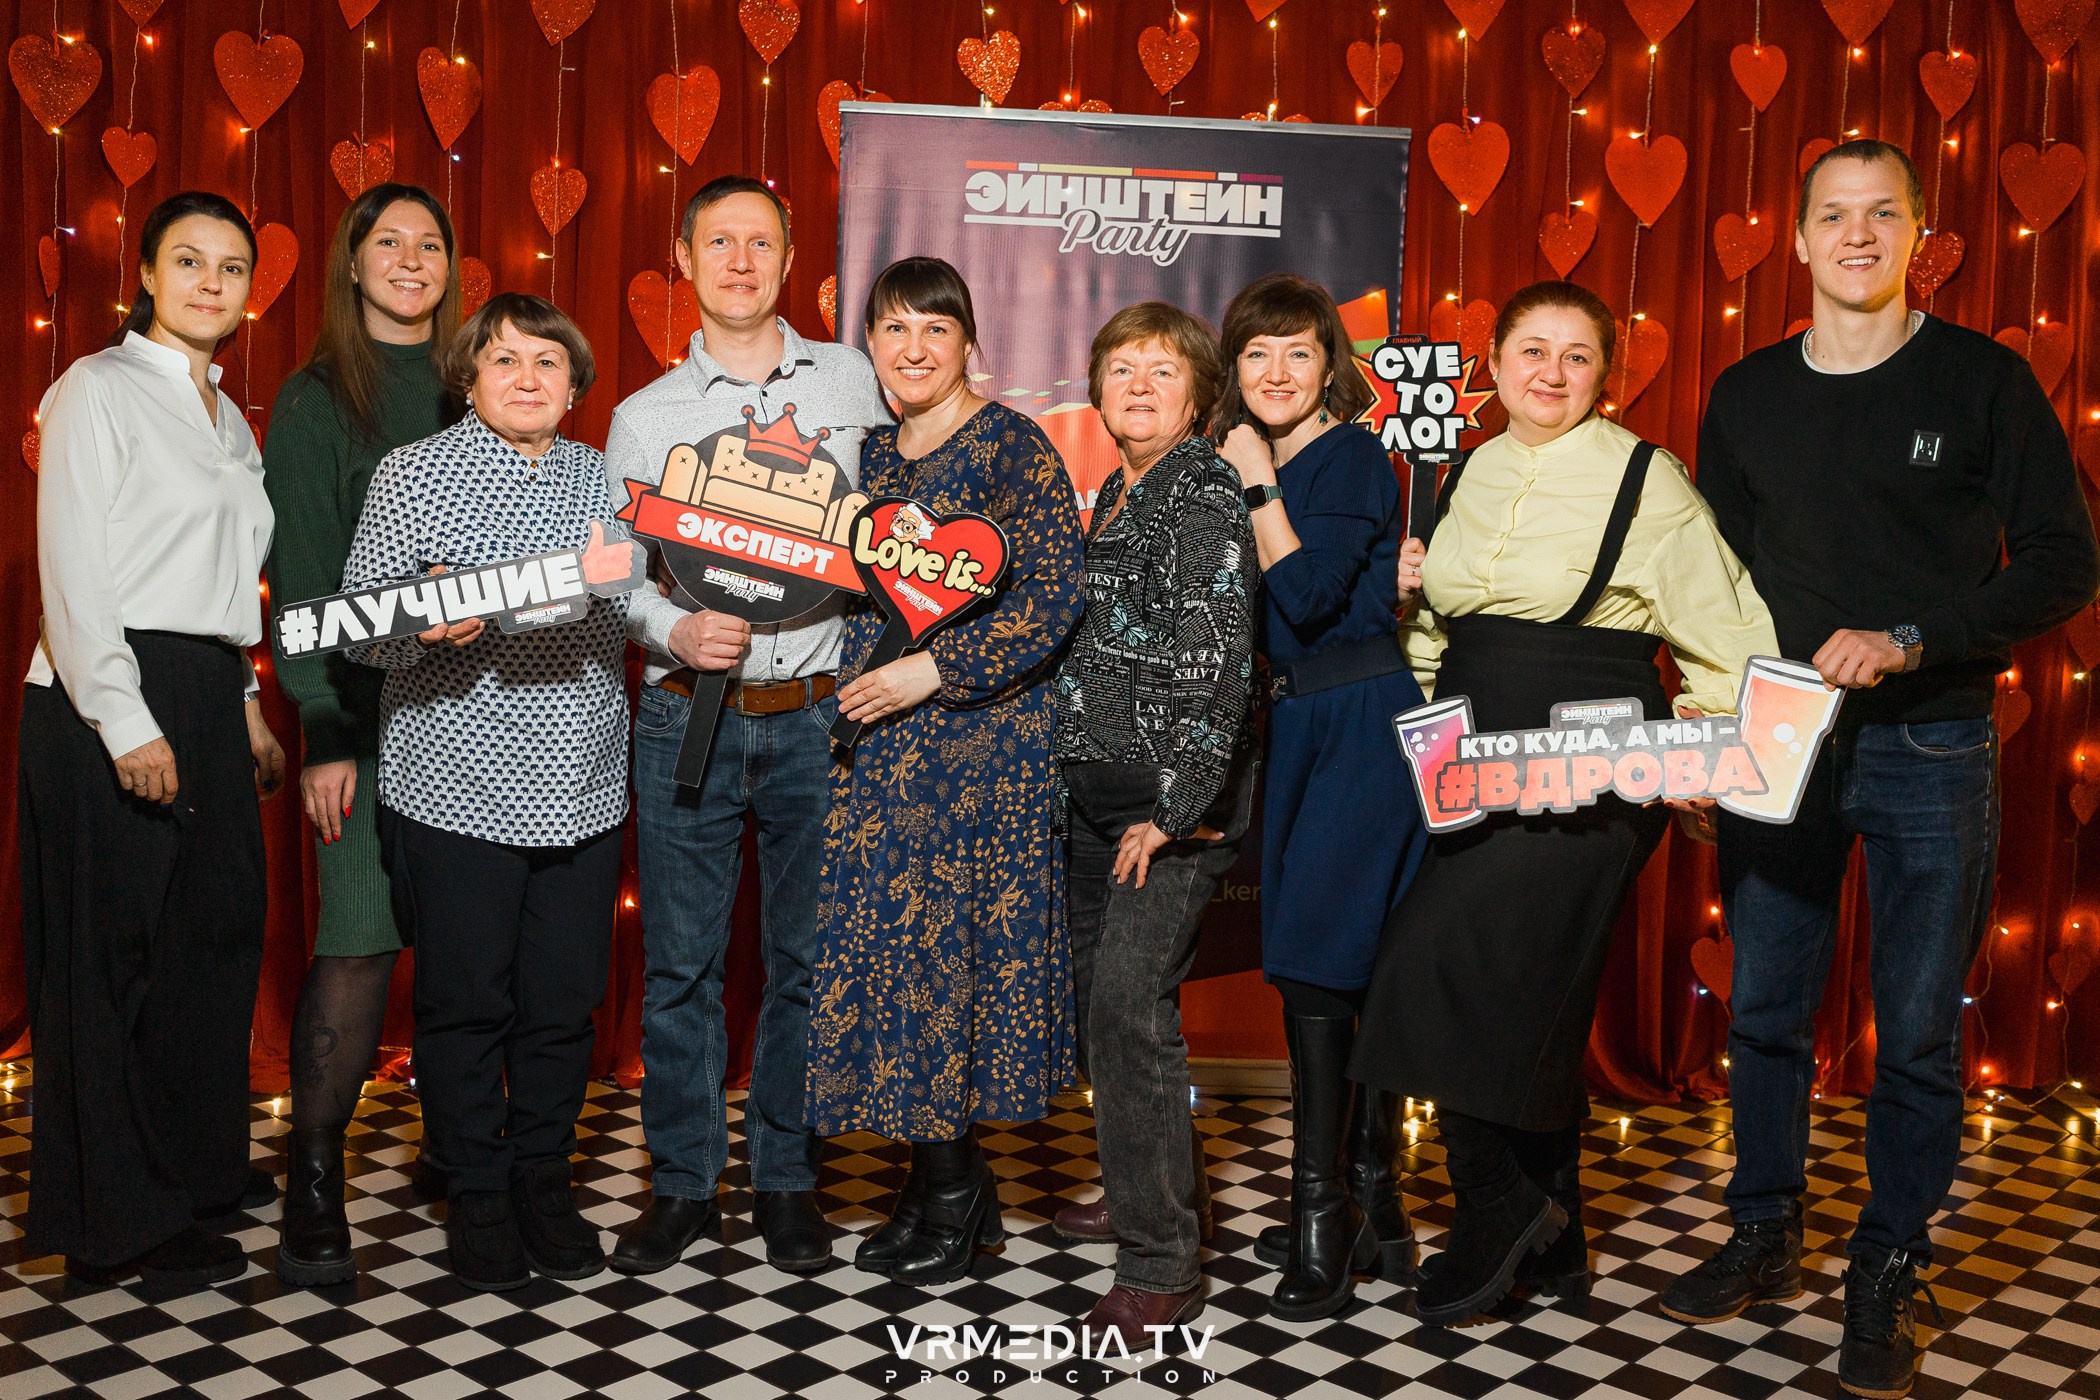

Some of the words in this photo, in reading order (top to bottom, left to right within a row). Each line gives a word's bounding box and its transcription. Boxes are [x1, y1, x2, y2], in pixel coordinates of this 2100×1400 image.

[965, 163, 1283, 226] ЭЙНШТЕЙН
[1059, 208, 1190, 266] Party
[1392, 336, 1422, 344] ГЛАВНЫЙ
[1374, 345, 1460, 380] СУЕ
[1396, 381, 1454, 415] ТО
[1381, 416, 1464, 450] ЛОГ
[676, 512, 834, 574] ЭКСПЕРТ
[854, 516, 945, 582] Love
[944, 551, 992, 596] is...
[703, 566, 785, 598] ЭЙНШТЕЙН
[715, 583, 760, 603] Party
[279, 552, 584, 656] #ЛУЧШИЕ
[1561, 704, 1632, 719] ЭЙНШТЕЙН
[1582, 715, 1612, 725] Party
[1460, 736, 1518, 758] КТО
[1524, 728, 1620, 754] КУДА,
[1625, 726, 1650, 747] А
[1657, 722, 1712, 745] МЫ
[1440, 747, 1765, 809] #ВДРОВА
